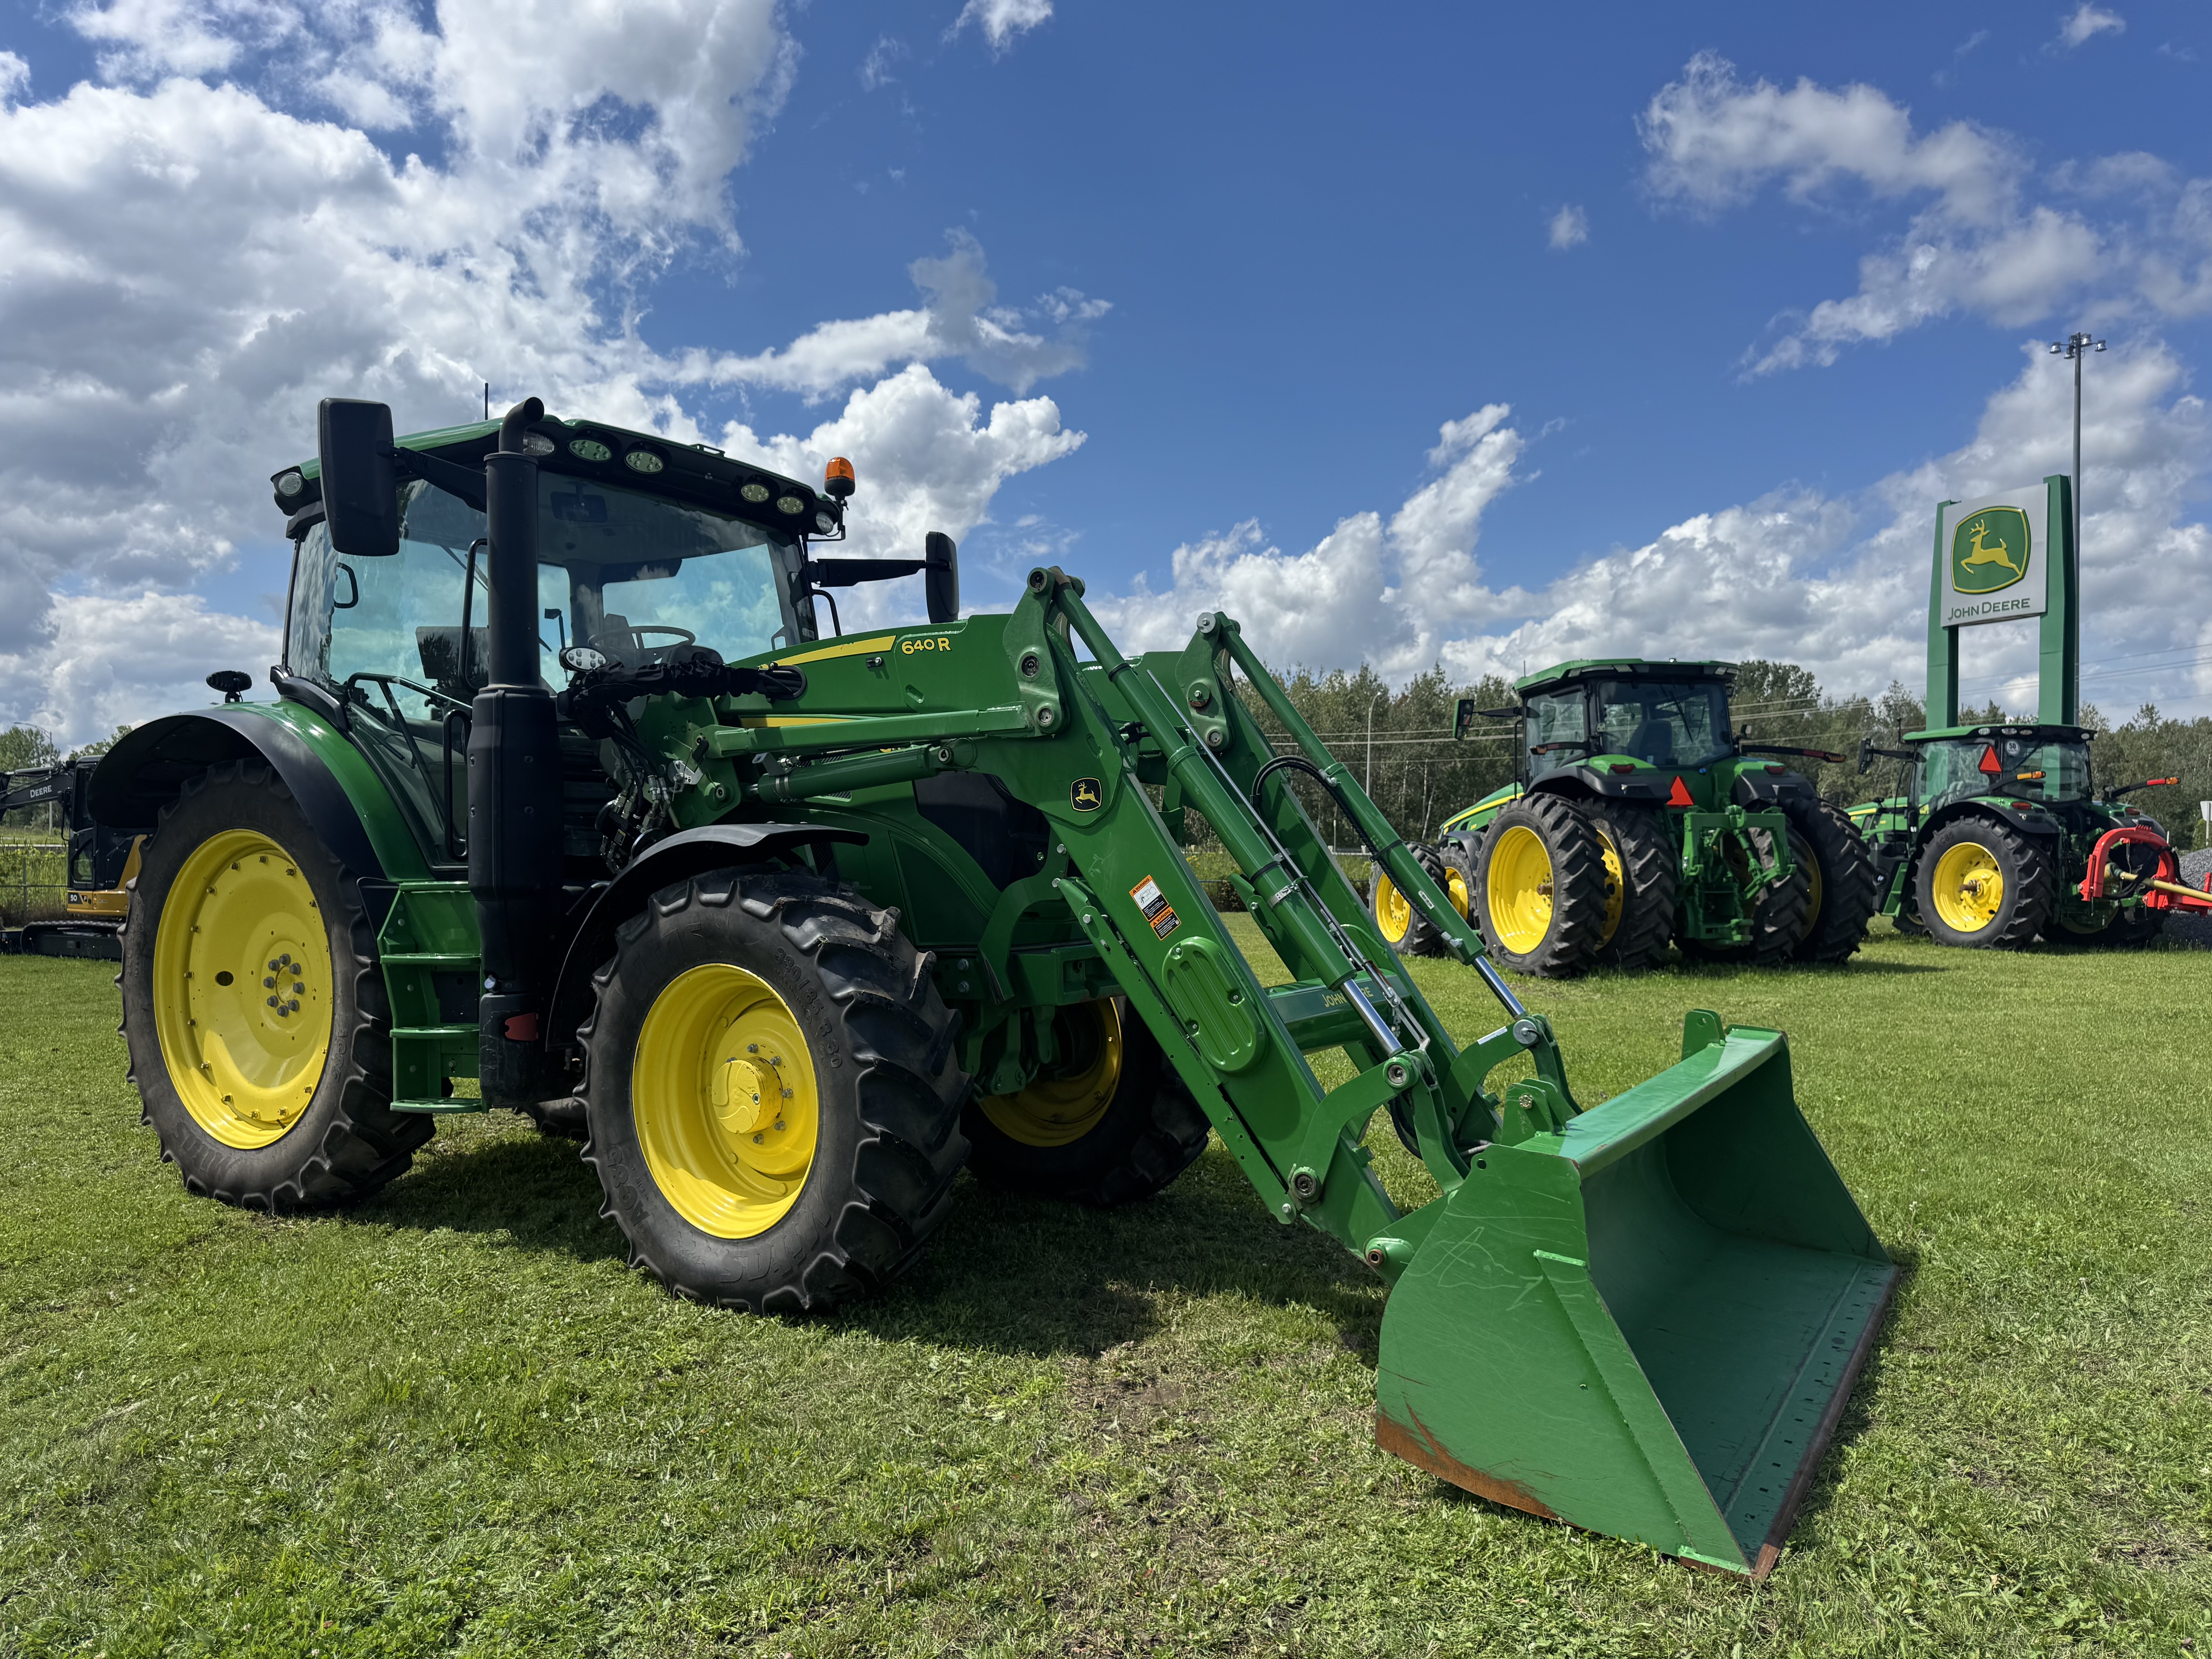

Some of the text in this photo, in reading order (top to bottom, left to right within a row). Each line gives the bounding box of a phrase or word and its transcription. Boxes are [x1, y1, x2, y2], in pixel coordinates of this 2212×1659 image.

[1948, 598, 2030, 620] JOHN DEERE
[902, 639, 935, 654] 640
[30, 785, 52, 798] DEERE
[1322, 993, 1347, 1007] JOHN
